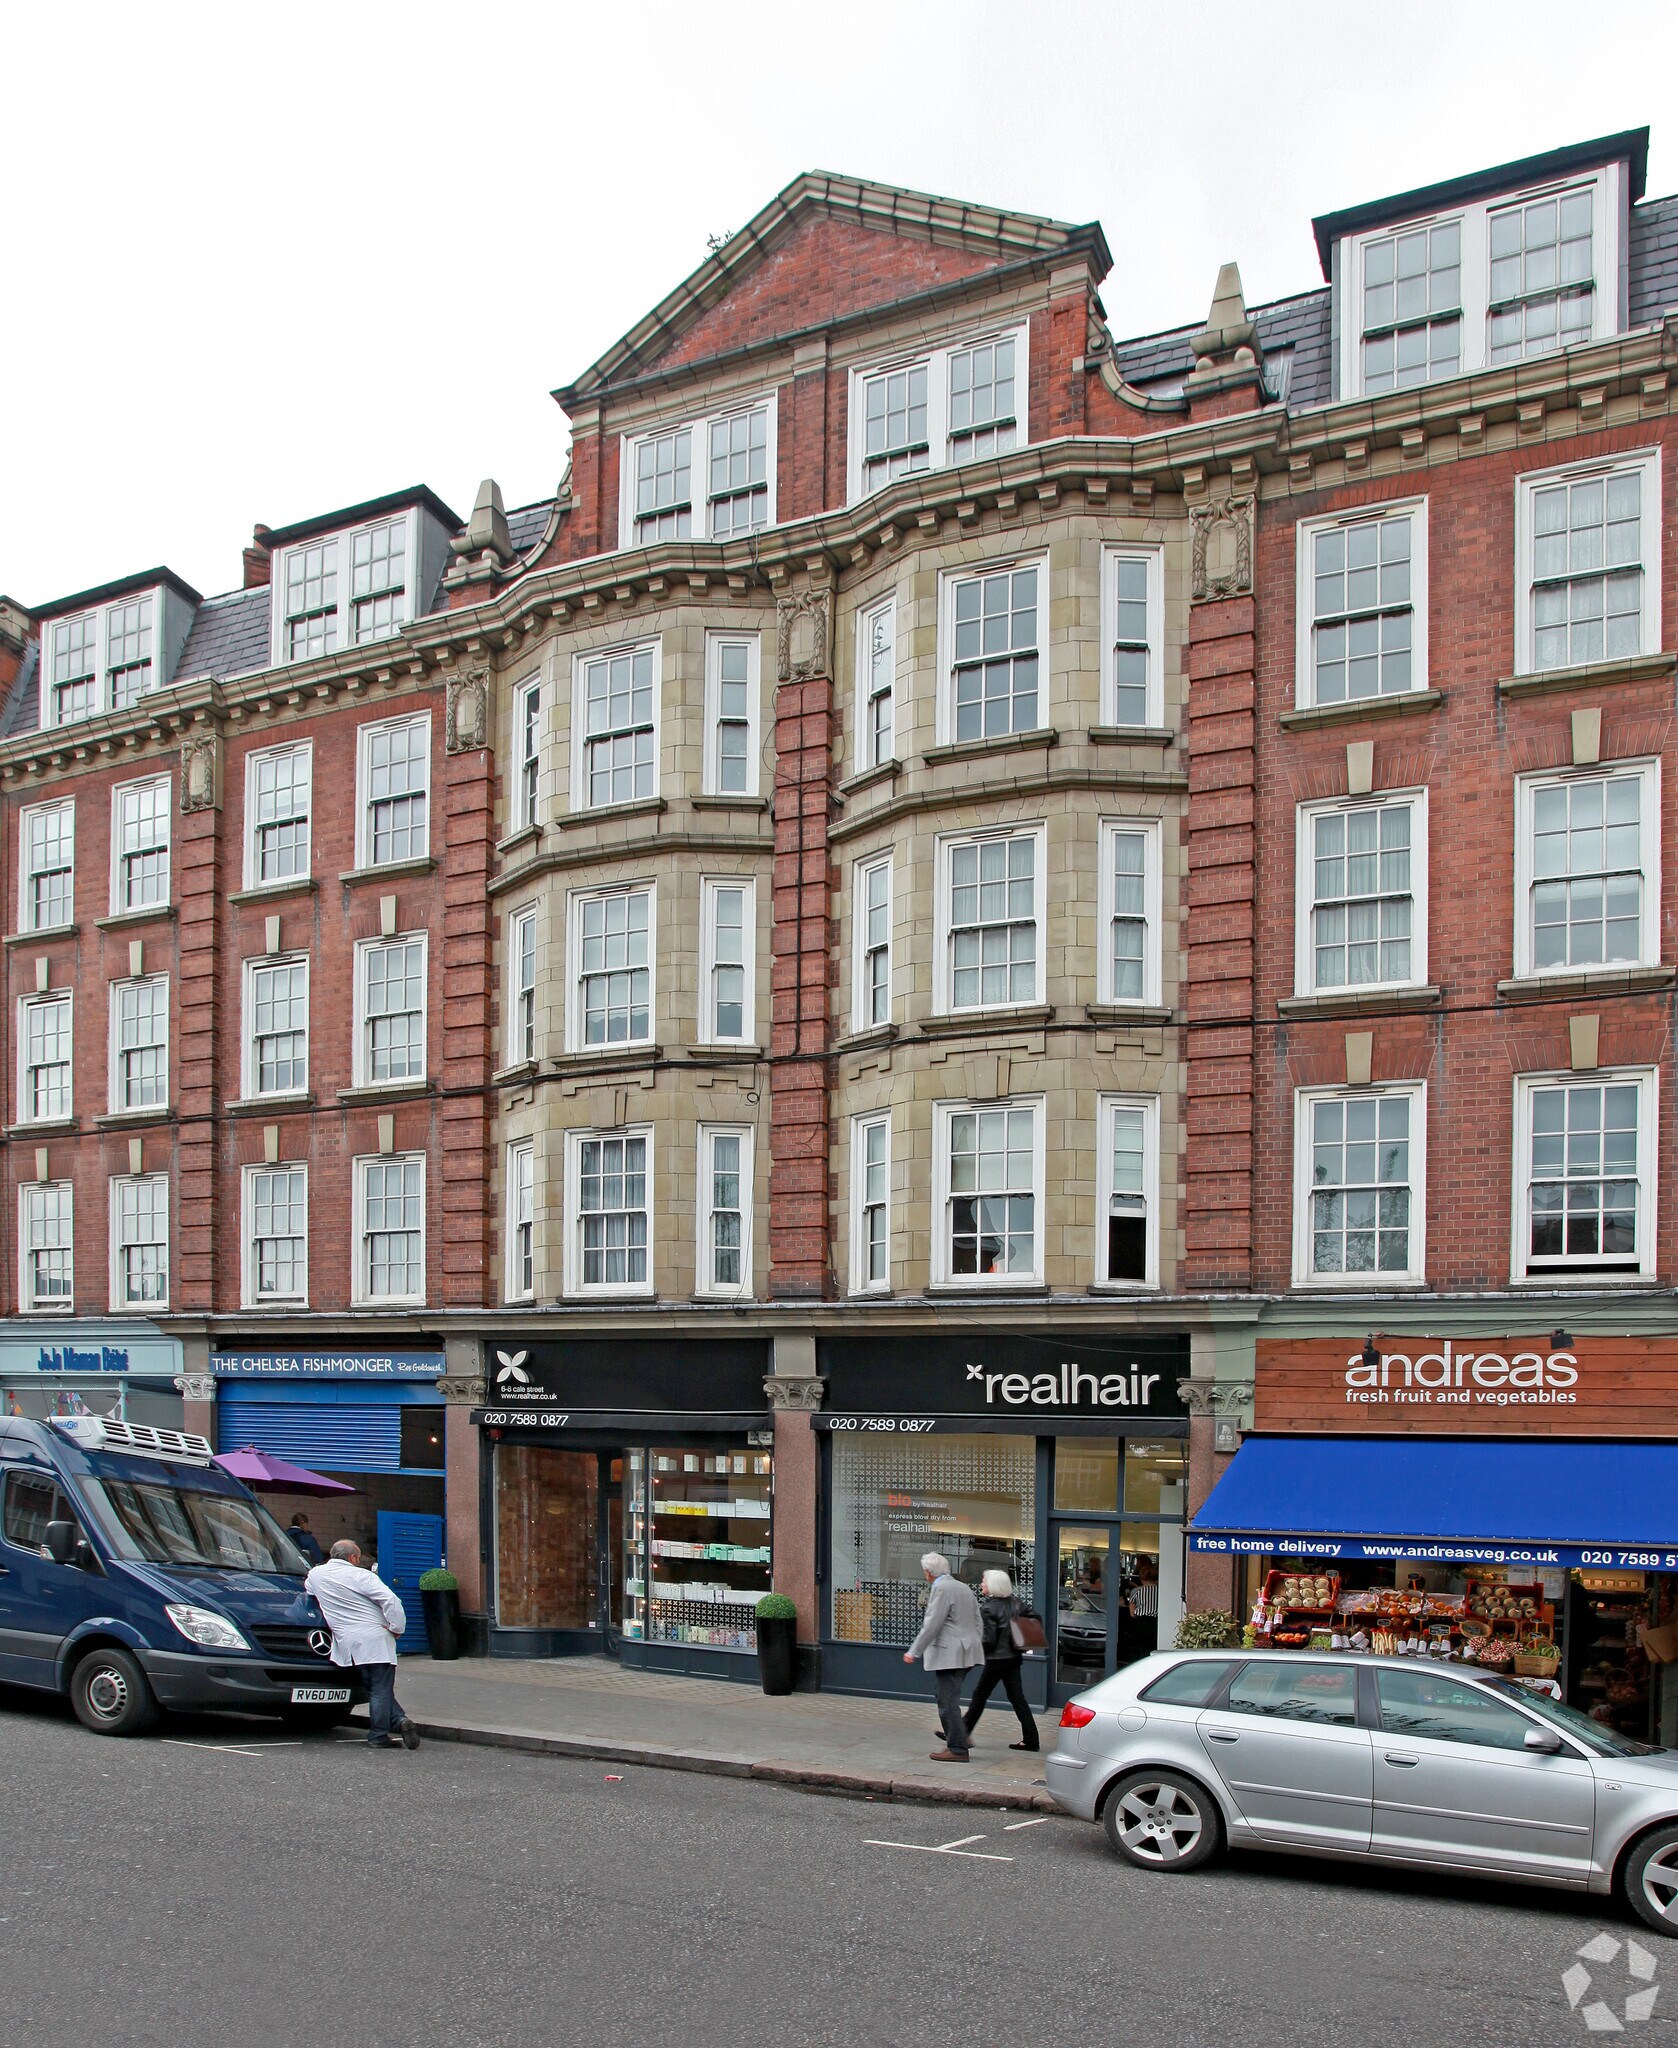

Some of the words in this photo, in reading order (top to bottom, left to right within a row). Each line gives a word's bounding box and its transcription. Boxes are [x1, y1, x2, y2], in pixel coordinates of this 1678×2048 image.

[212, 1358, 239, 1371] THE
[242, 1358, 299, 1371] CHELSEA
[303, 1358, 393, 1372] FISHMONGER
[1345, 1341, 1578, 1387] andreas
[527, 1385, 544, 1393] street
[985, 1364, 1161, 1406] realhair
[501, 1392, 558, 1400] www.realhair.co.uk
[1345, 1389, 1389, 1403] fresh
[1393, 1389, 1432, 1403] fruit
[1436, 1389, 1471, 1403] and
[1475, 1389, 1577, 1407] vegetables
[484, 1413, 507, 1424] 020
[510, 1414, 537, 1426] 7589
[540, 1414, 569, 1427] 0877
[829, 1417, 857, 1430] 020
[860, 1418, 896, 1431] 7589
[899, 1419, 936, 1432] 0877
[888, 1493, 911, 1507] blo
[888, 1521, 932, 1533] realhair
[1196, 1537, 1227, 1550] free
[1230, 1538, 1274, 1552] home
[1278, 1540, 1341, 1556] delivery
[1363, 1544, 1559, 1563] www.andreasveg.co.uk
[1581, 1551, 1612, 1564] 020
[1618, 1552, 1660, 1566] 7589
[1665, 1553, 1678, 1567] 5
[297, 1690, 325, 1700] RV60
[328, 1690, 347, 1700] DND
